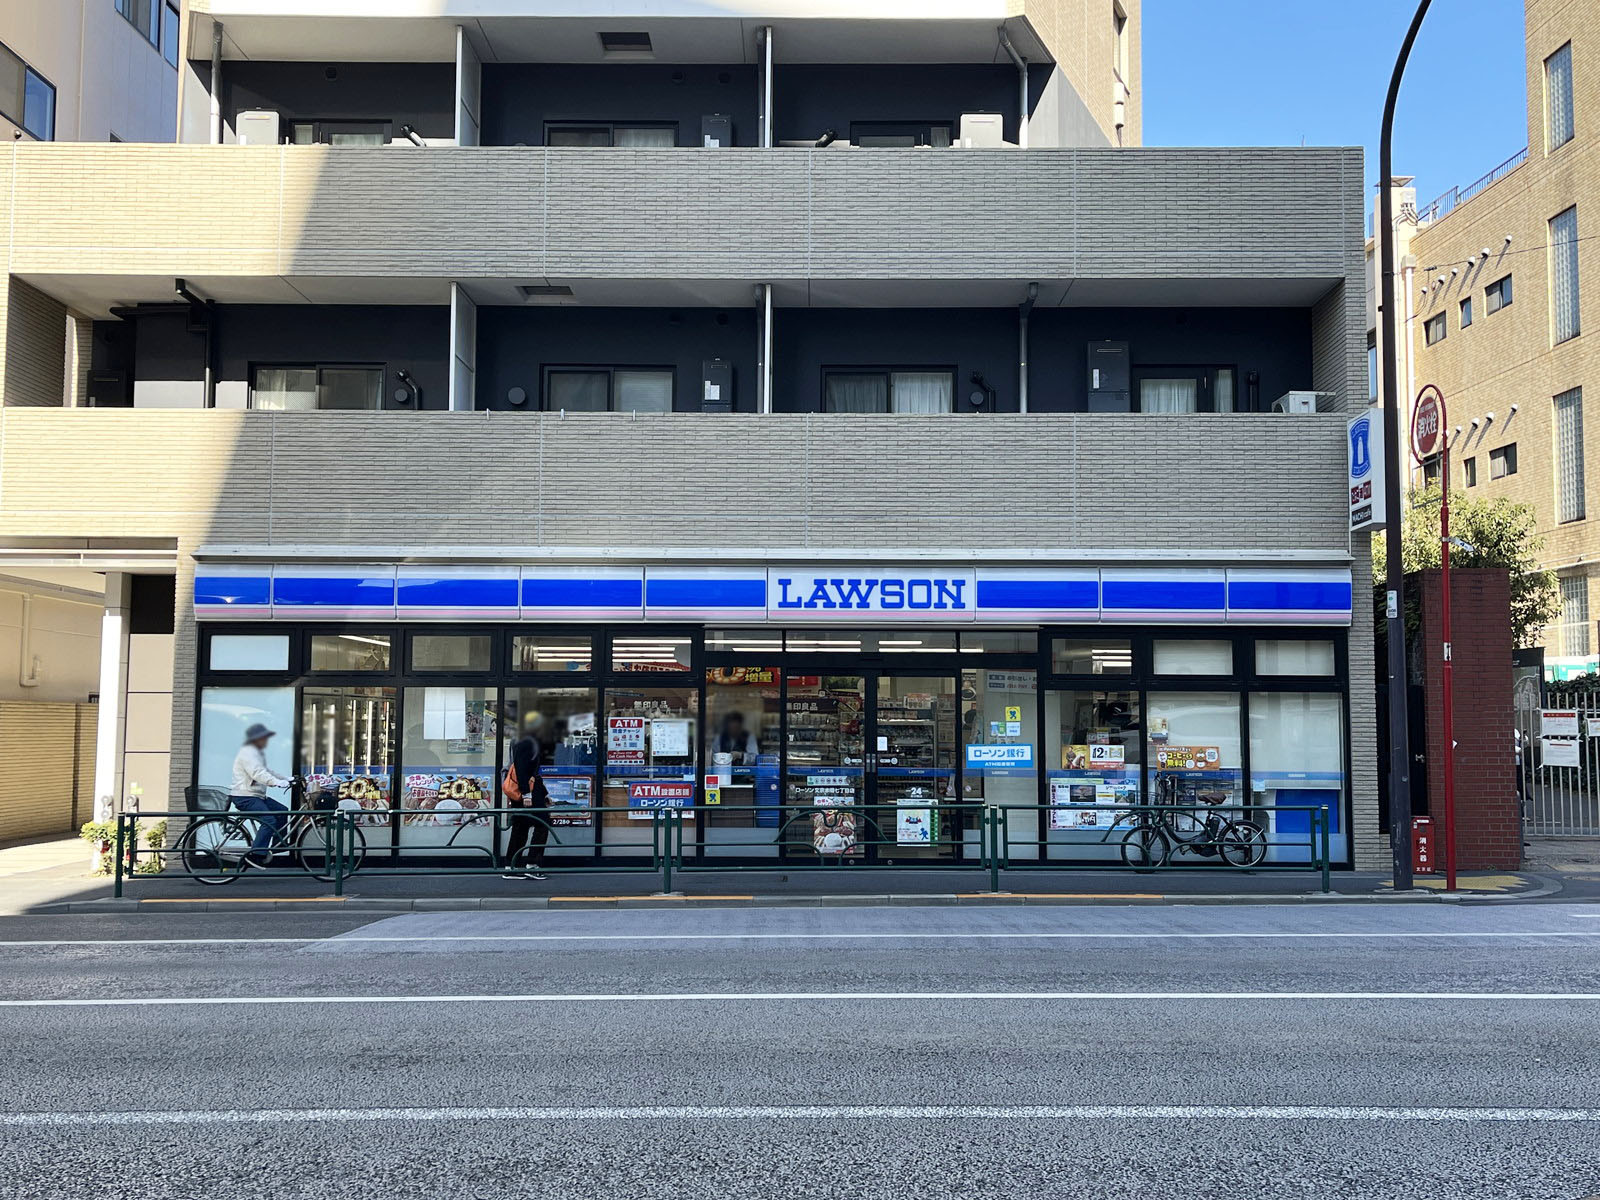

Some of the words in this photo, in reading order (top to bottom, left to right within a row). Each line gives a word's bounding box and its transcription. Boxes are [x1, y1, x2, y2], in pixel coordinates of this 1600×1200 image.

[1417, 411, 1438, 439] 消火栓
[778, 579, 966, 609] LAWSON
[745, 673, 772, 683] 増量
[634, 700, 668, 710] 無印良品
[615, 719, 639, 728] ATM
[973, 748, 1025, 758] ローソン銀行
[911, 787, 923, 795] 24
[640, 798, 684, 807] ローソン銀行
[1419, 837, 1428, 862] 消火器
